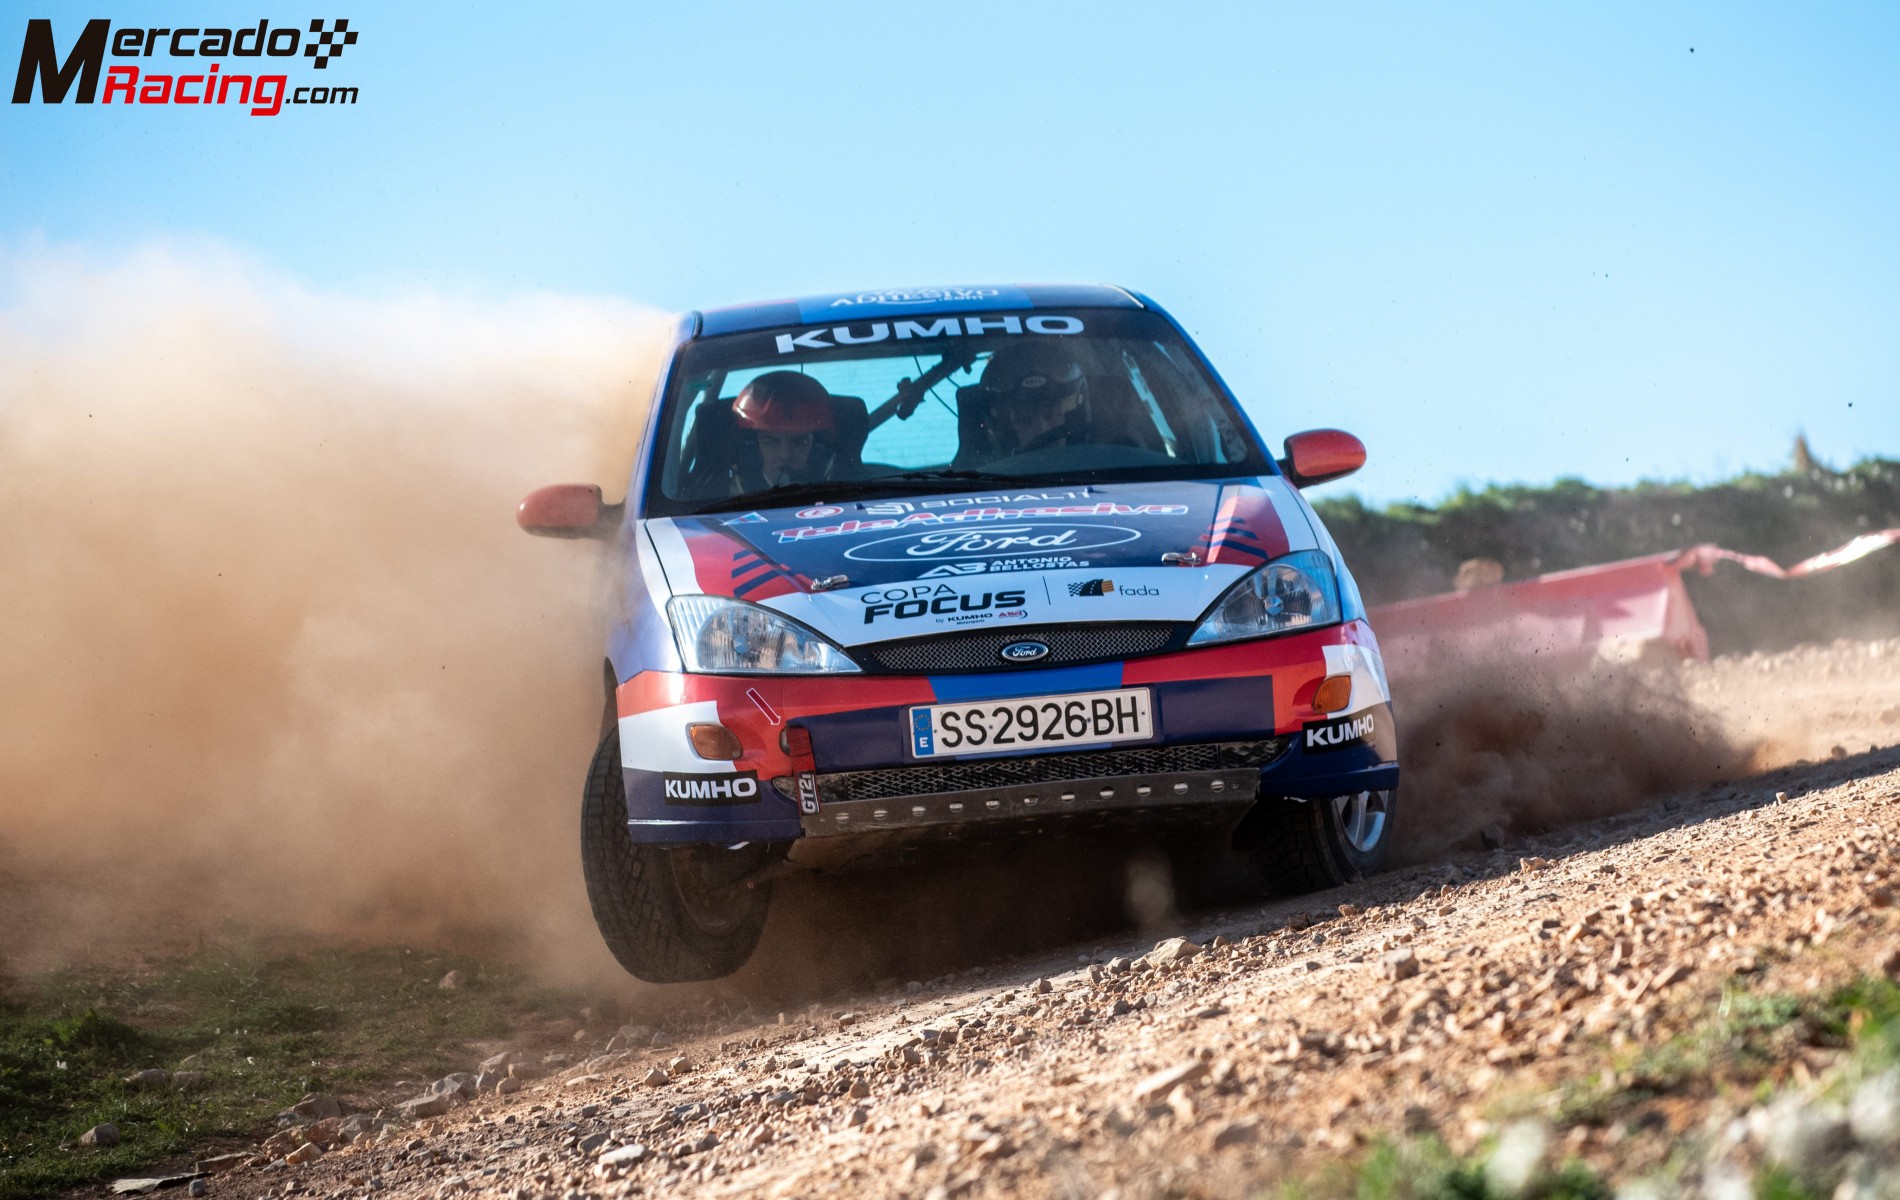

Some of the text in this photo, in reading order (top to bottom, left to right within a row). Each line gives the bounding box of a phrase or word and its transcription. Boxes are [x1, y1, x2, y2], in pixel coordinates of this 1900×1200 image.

[775, 315, 1084, 354] KUMHO
[772, 502, 1189, 544] TeleAdhesivo
[906, 526, 1078, 556] Ford
[989, 560, 1090, 572] BELLOSTAS
[992, 556, 1072, 566] ANTONIO
[860, 583, 957, 605] COPA
[1119, 584, 1160, 596] fada
[863, 589, 1026, 625] FOCUS
[947, 612, 993, 622] KUMHO
[1012, 645, 1038, 657] Ford
[1306, 713, 1375, 747] KUMHO
[919, 737, 929, 748] E
[665, 777, 757, 799] KUMHO
